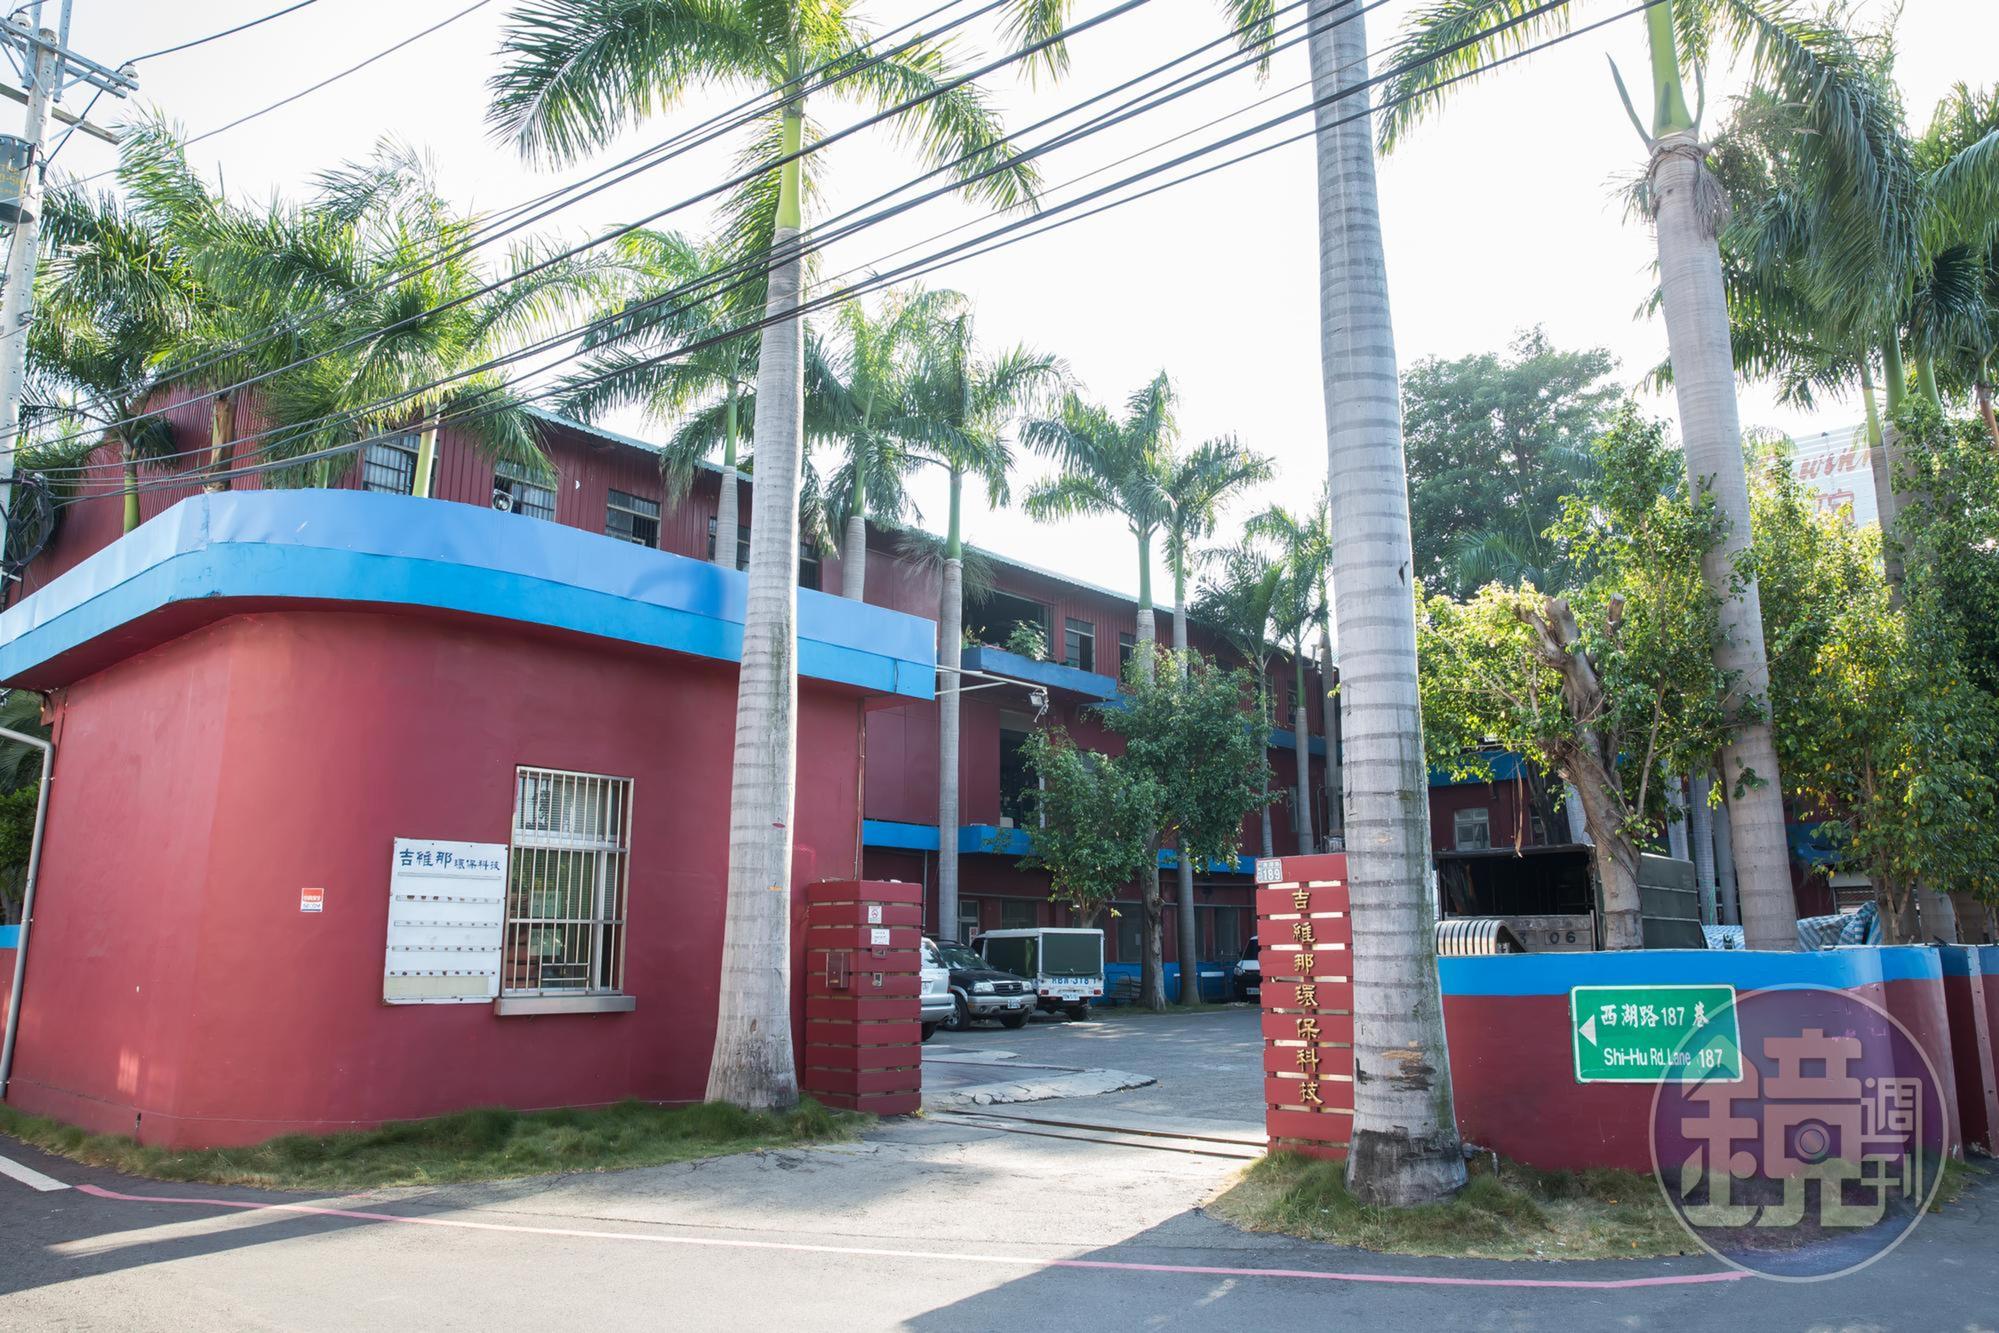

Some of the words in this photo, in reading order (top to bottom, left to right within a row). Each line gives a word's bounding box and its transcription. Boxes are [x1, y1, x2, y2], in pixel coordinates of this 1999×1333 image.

[1262, 868, 1281, 881] 189
[1603, 1048, 1648, 1067] Shi-Hu
[1667, 1048, 1692, 1067] Lane
[1698, 1049, 1723, 1068] 187
